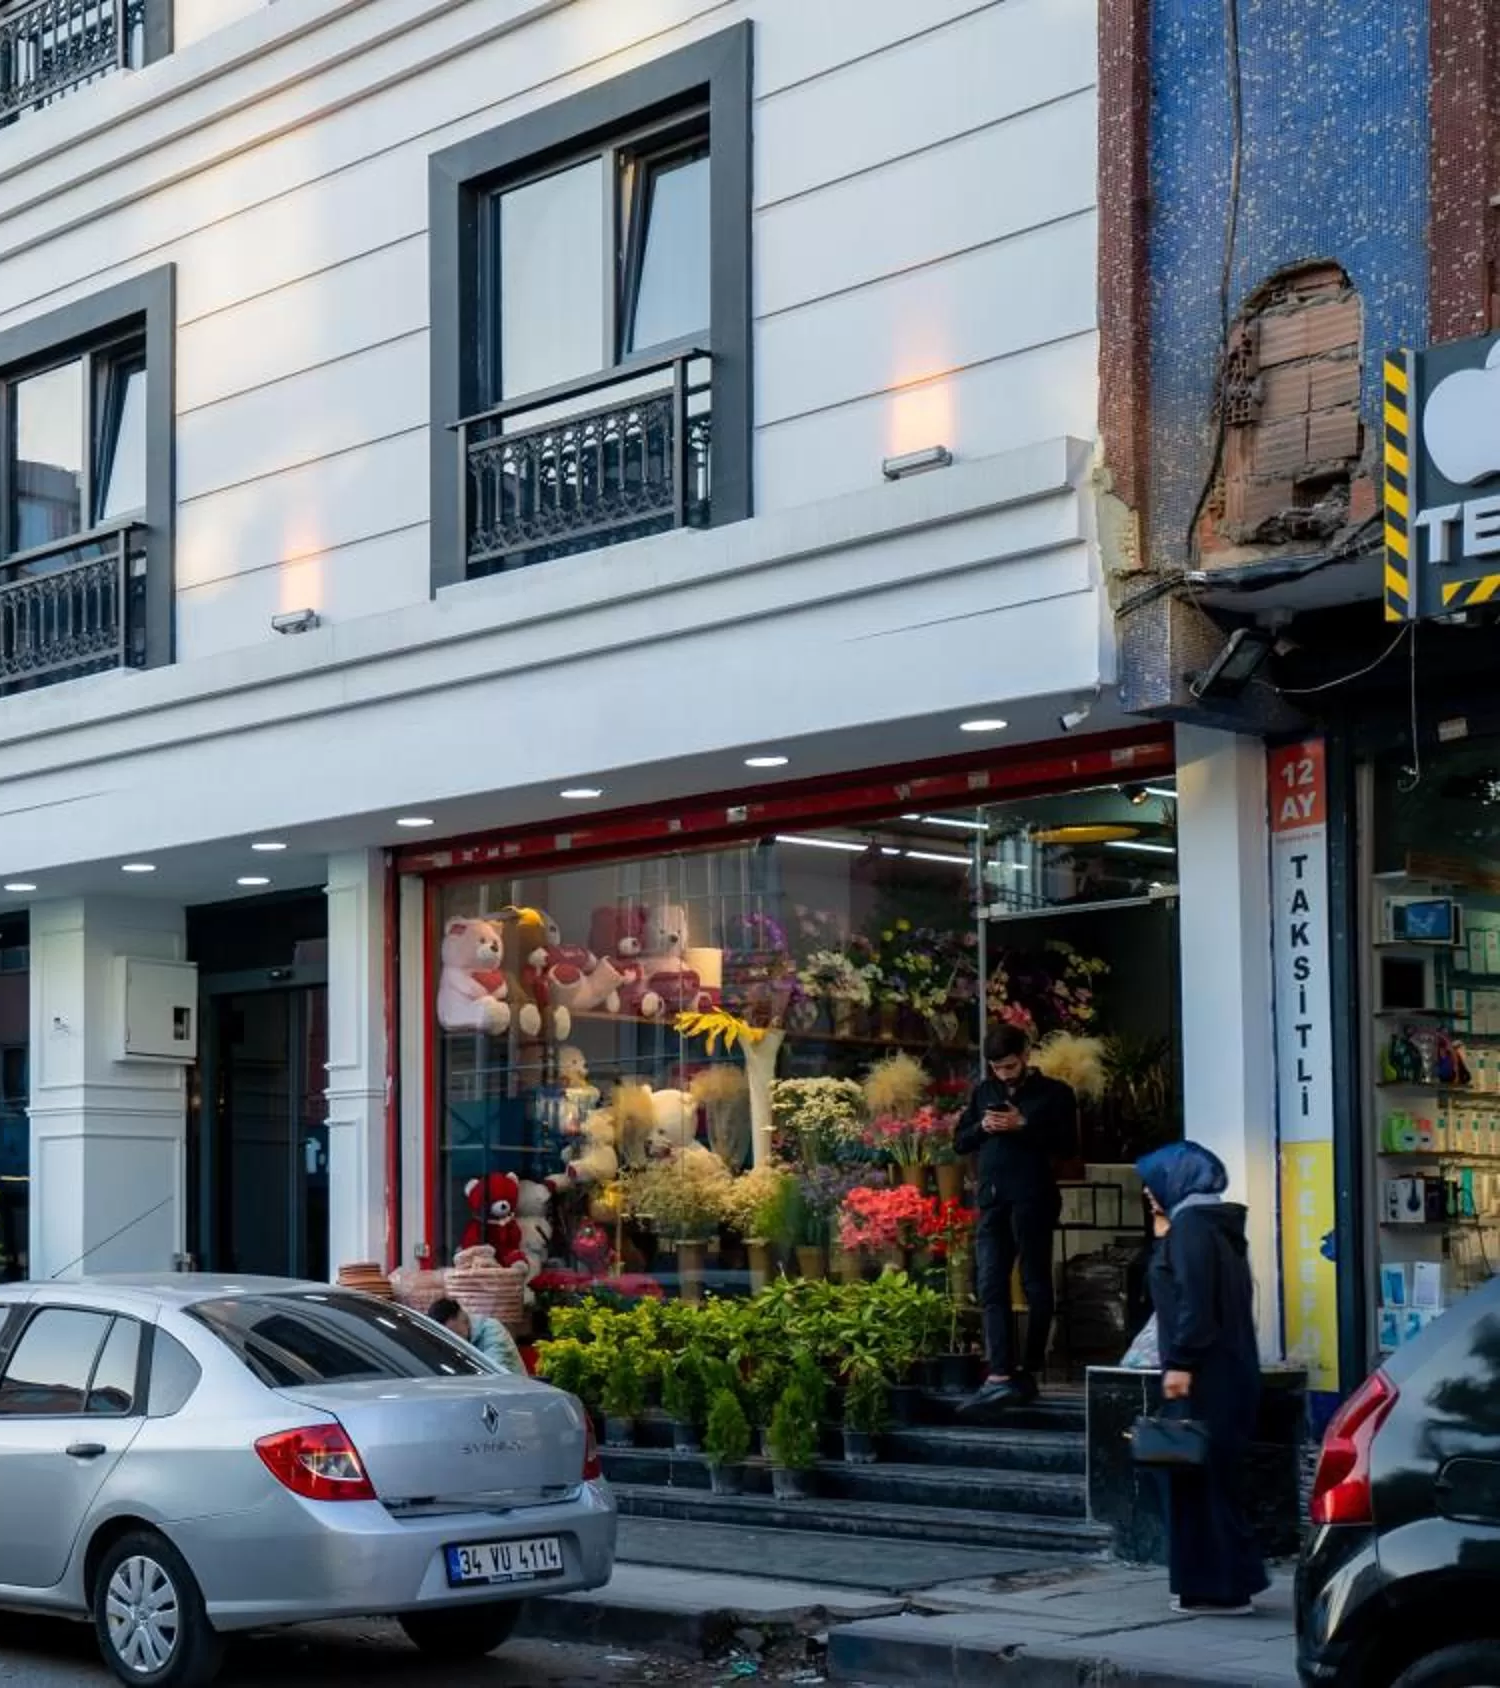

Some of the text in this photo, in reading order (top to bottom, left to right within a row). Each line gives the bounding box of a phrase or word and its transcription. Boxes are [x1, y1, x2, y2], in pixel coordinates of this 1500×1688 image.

[1282, 758, 1316, 788] 12
[1280, 791, 1317, 822] AY
[460, 1540, 558, 1575] 34 VU 4114
